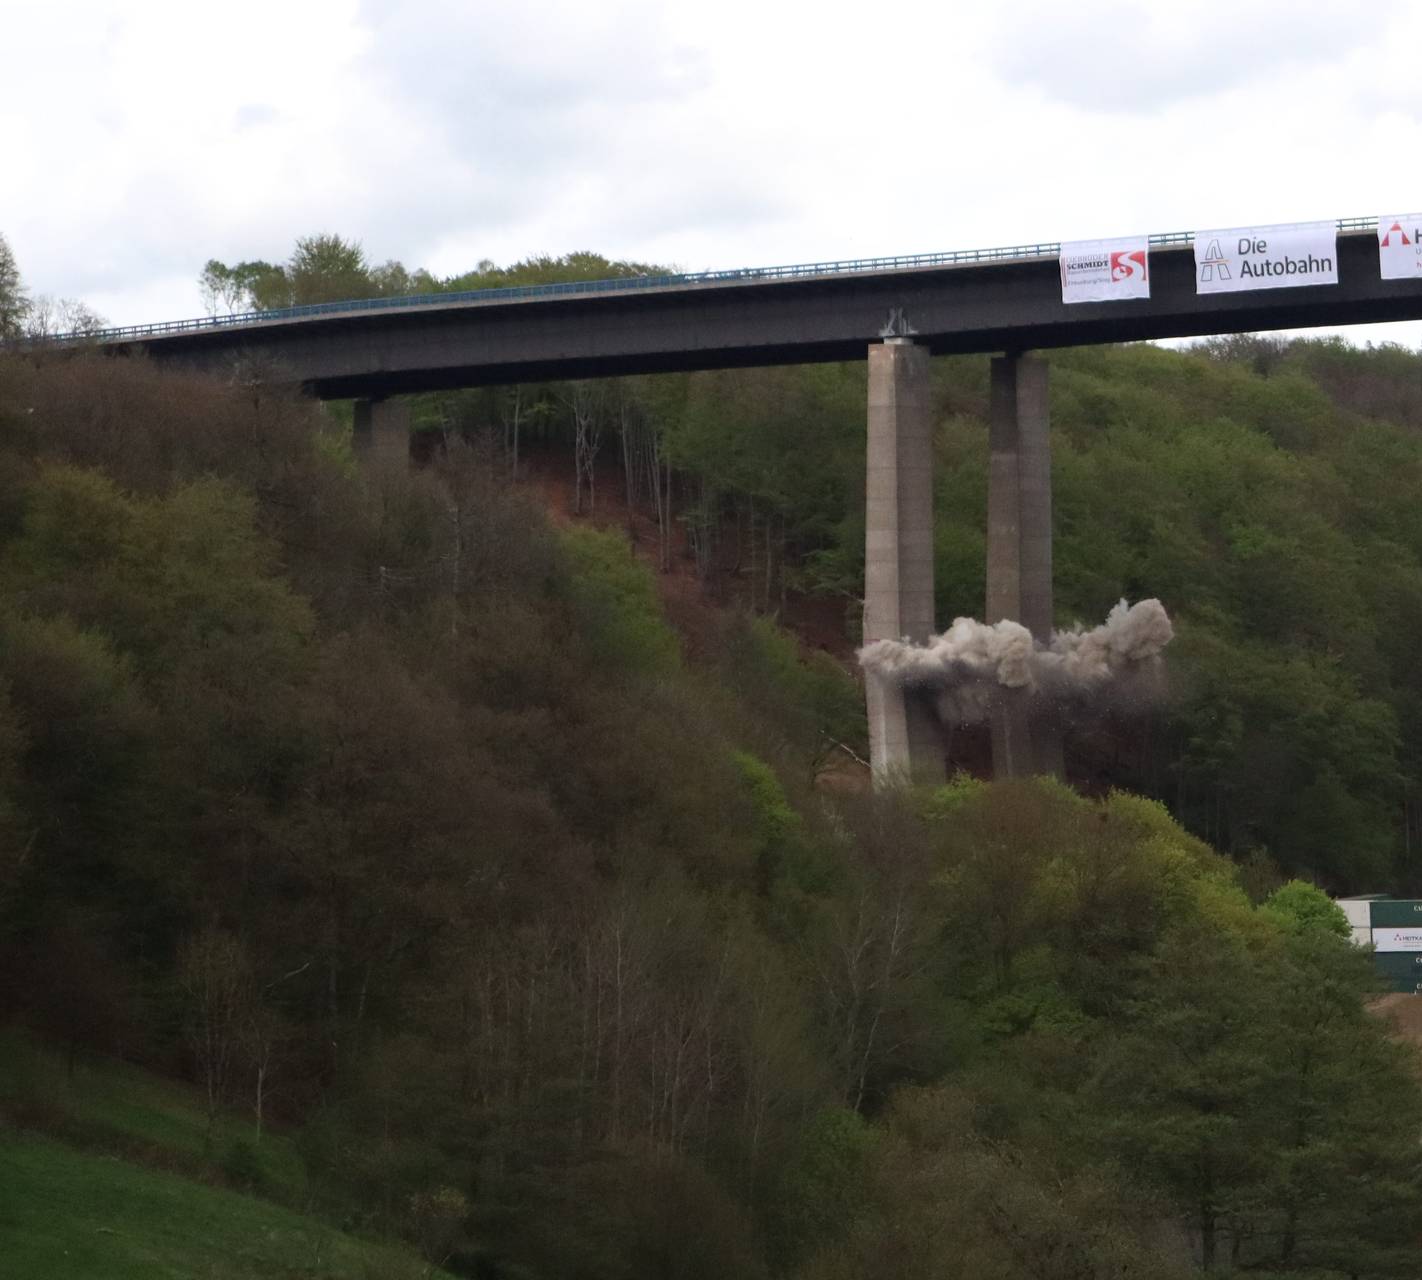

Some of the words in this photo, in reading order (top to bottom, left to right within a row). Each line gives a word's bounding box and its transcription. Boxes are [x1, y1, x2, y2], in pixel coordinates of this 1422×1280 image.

[1238, 237, 1267, 255] Die
[1066, 260, 1109, 270] SCHMIDT
[1240, 254, 1333, 278] Autobahn
